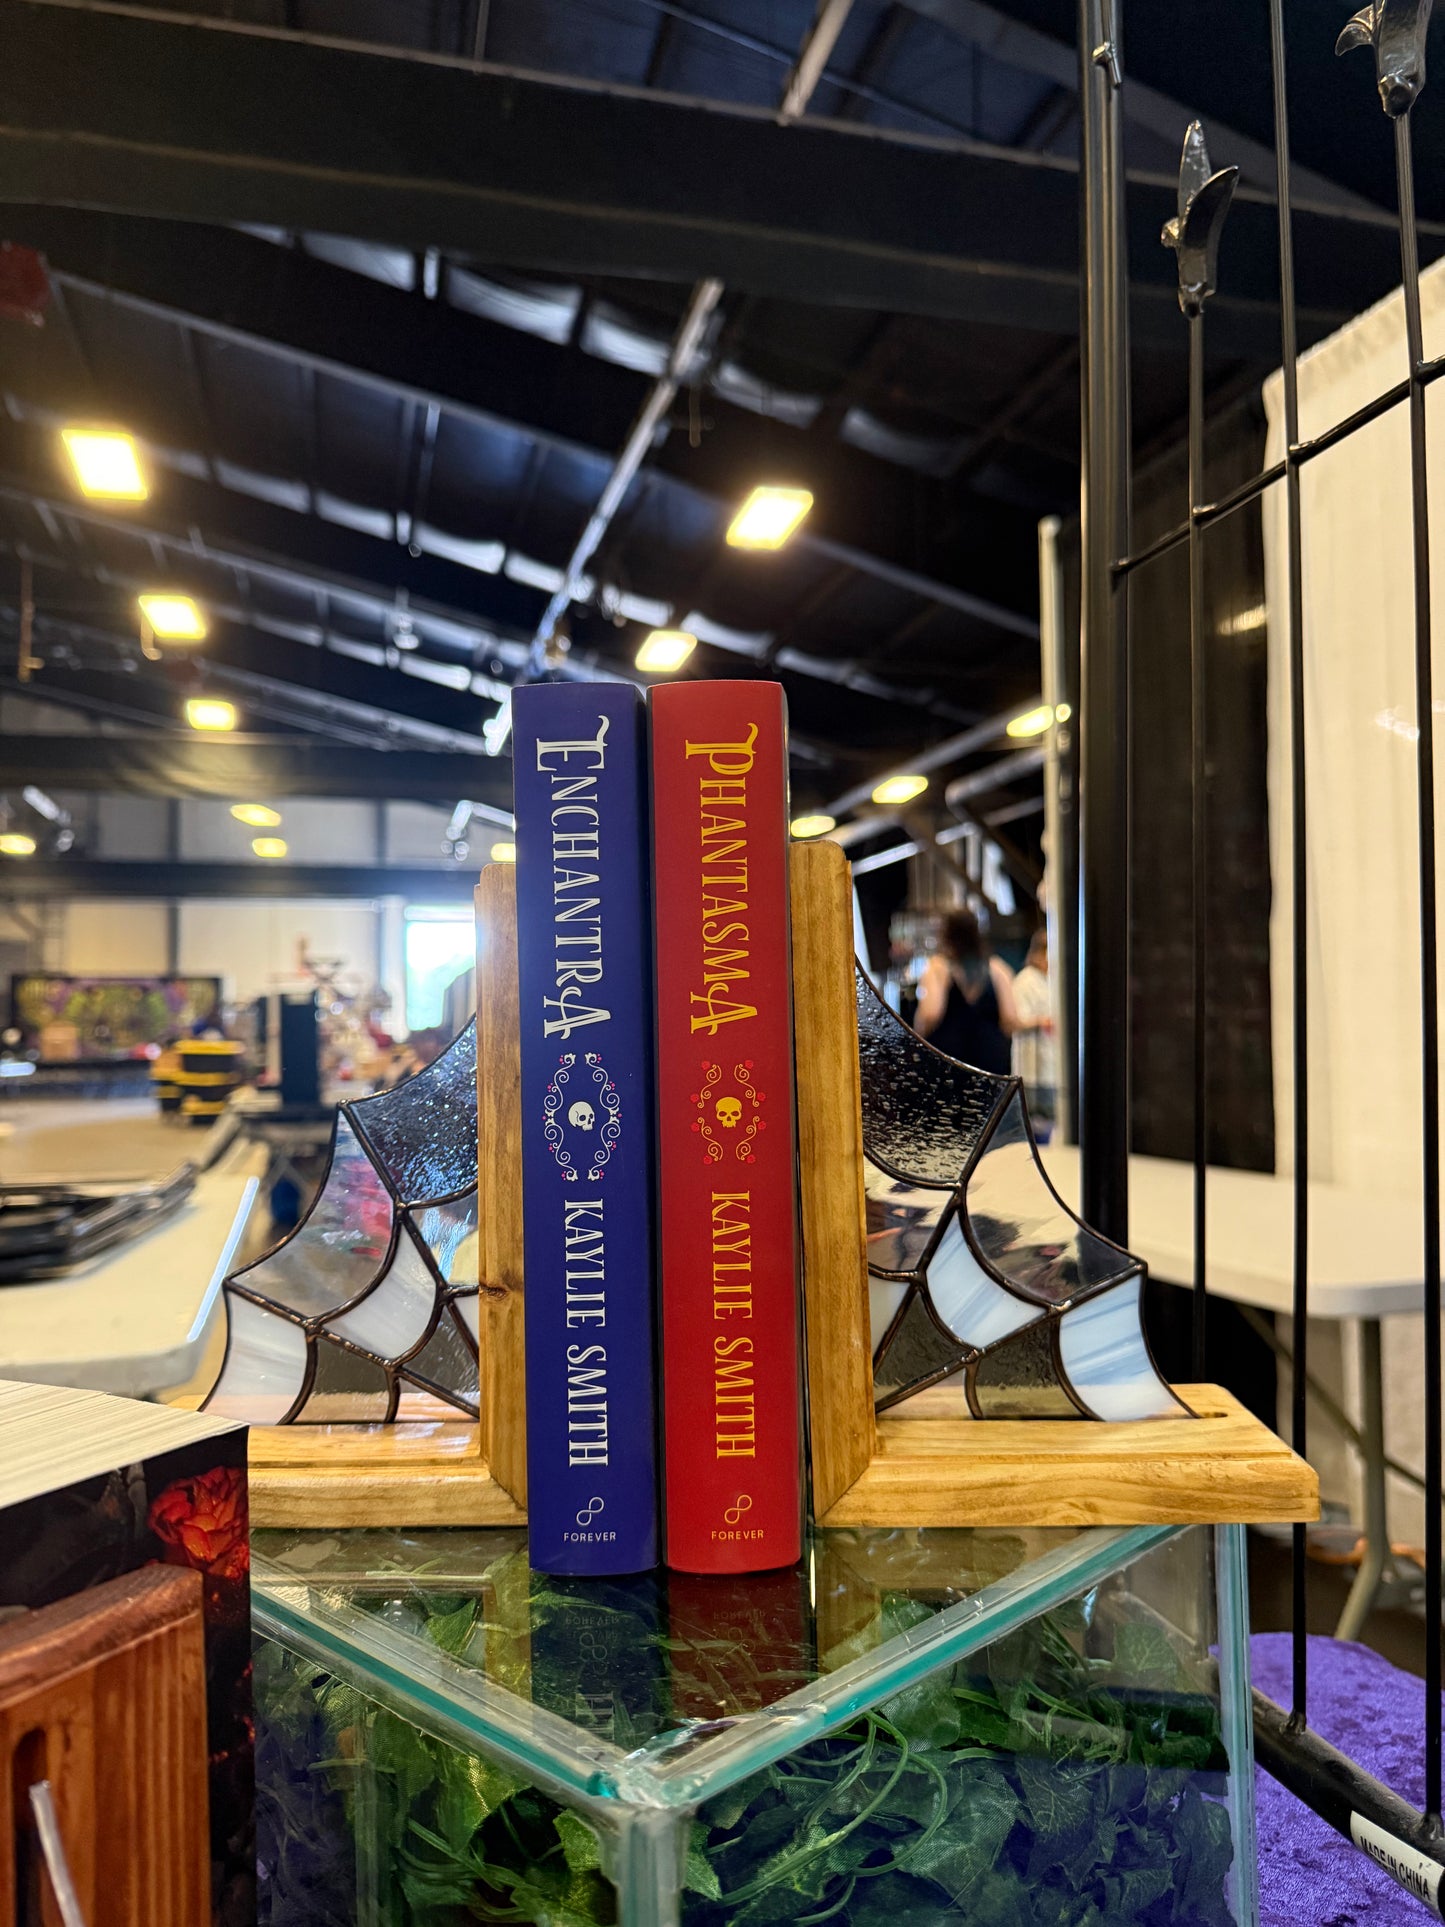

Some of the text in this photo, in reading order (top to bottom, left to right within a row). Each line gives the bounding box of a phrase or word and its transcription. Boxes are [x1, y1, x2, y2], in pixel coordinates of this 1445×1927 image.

[536, 715, 611, 1040] ENCHANTRA
[685, 723, 758, 1036] PHANTASMA
[564, 1198, 609, 1468] KAYLIE SMITH
[711, 1190, 756, 1459] KAYLIE SMITH
[563, 1531, 617, 1542] FOREVER
[711, 1529, 764, 1540] FOREVER
[1398, 1862, 1431, 1901] CHINA
